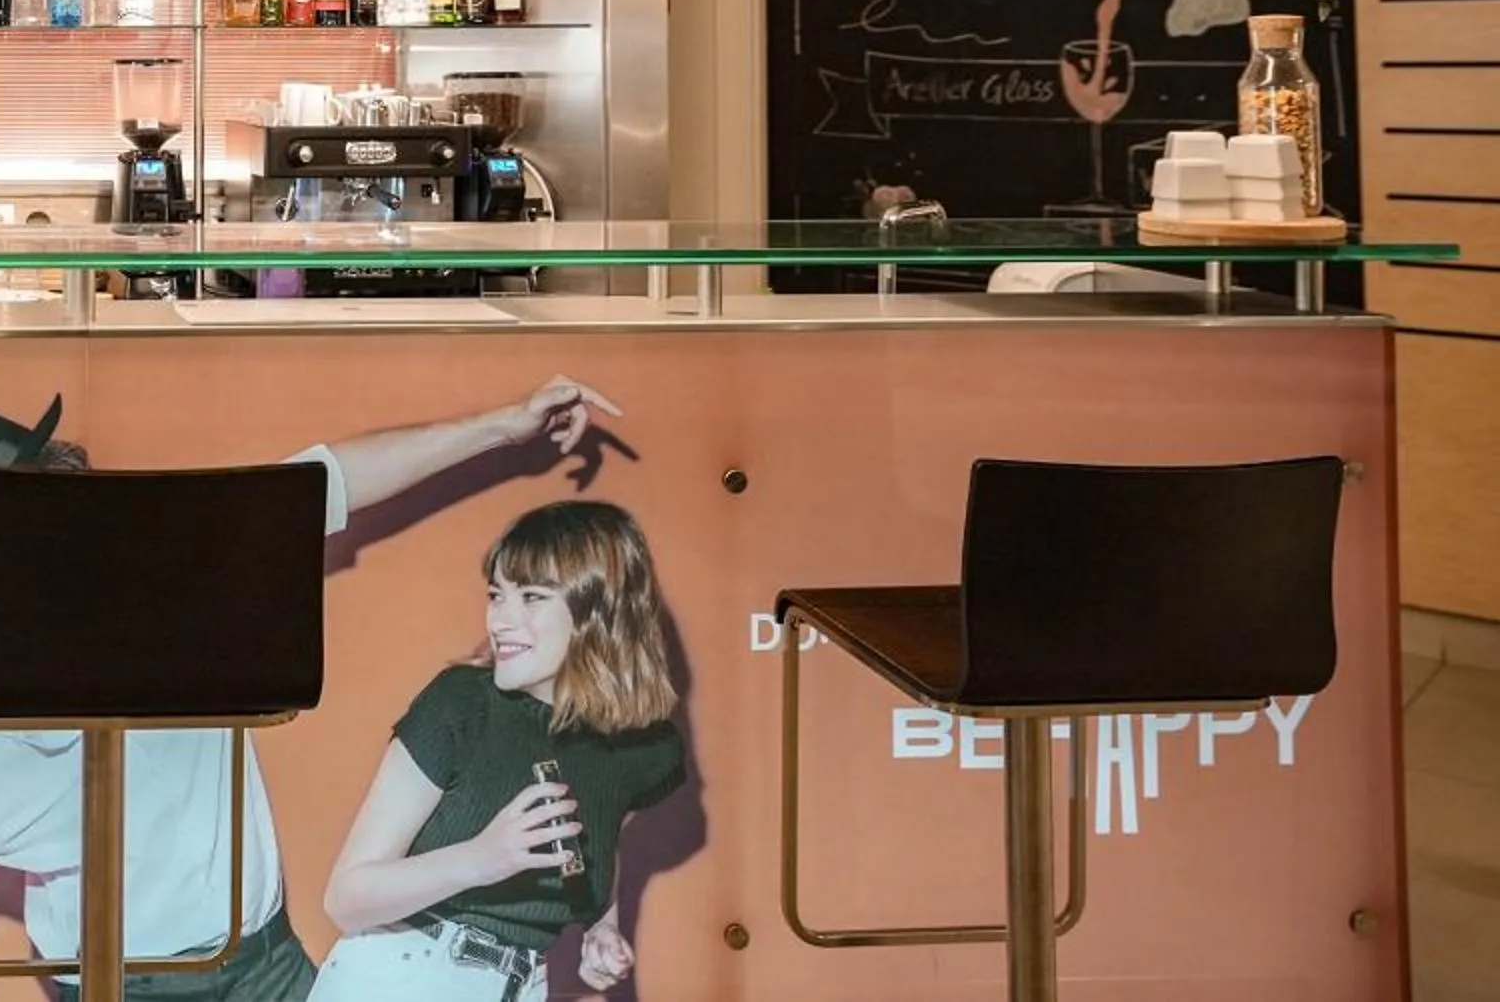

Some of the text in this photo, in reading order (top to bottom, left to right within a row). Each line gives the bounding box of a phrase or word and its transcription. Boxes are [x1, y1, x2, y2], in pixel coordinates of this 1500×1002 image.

[982, 68, 1055, 106] Glass
[892, 695, 1314, 834] BE APPY
